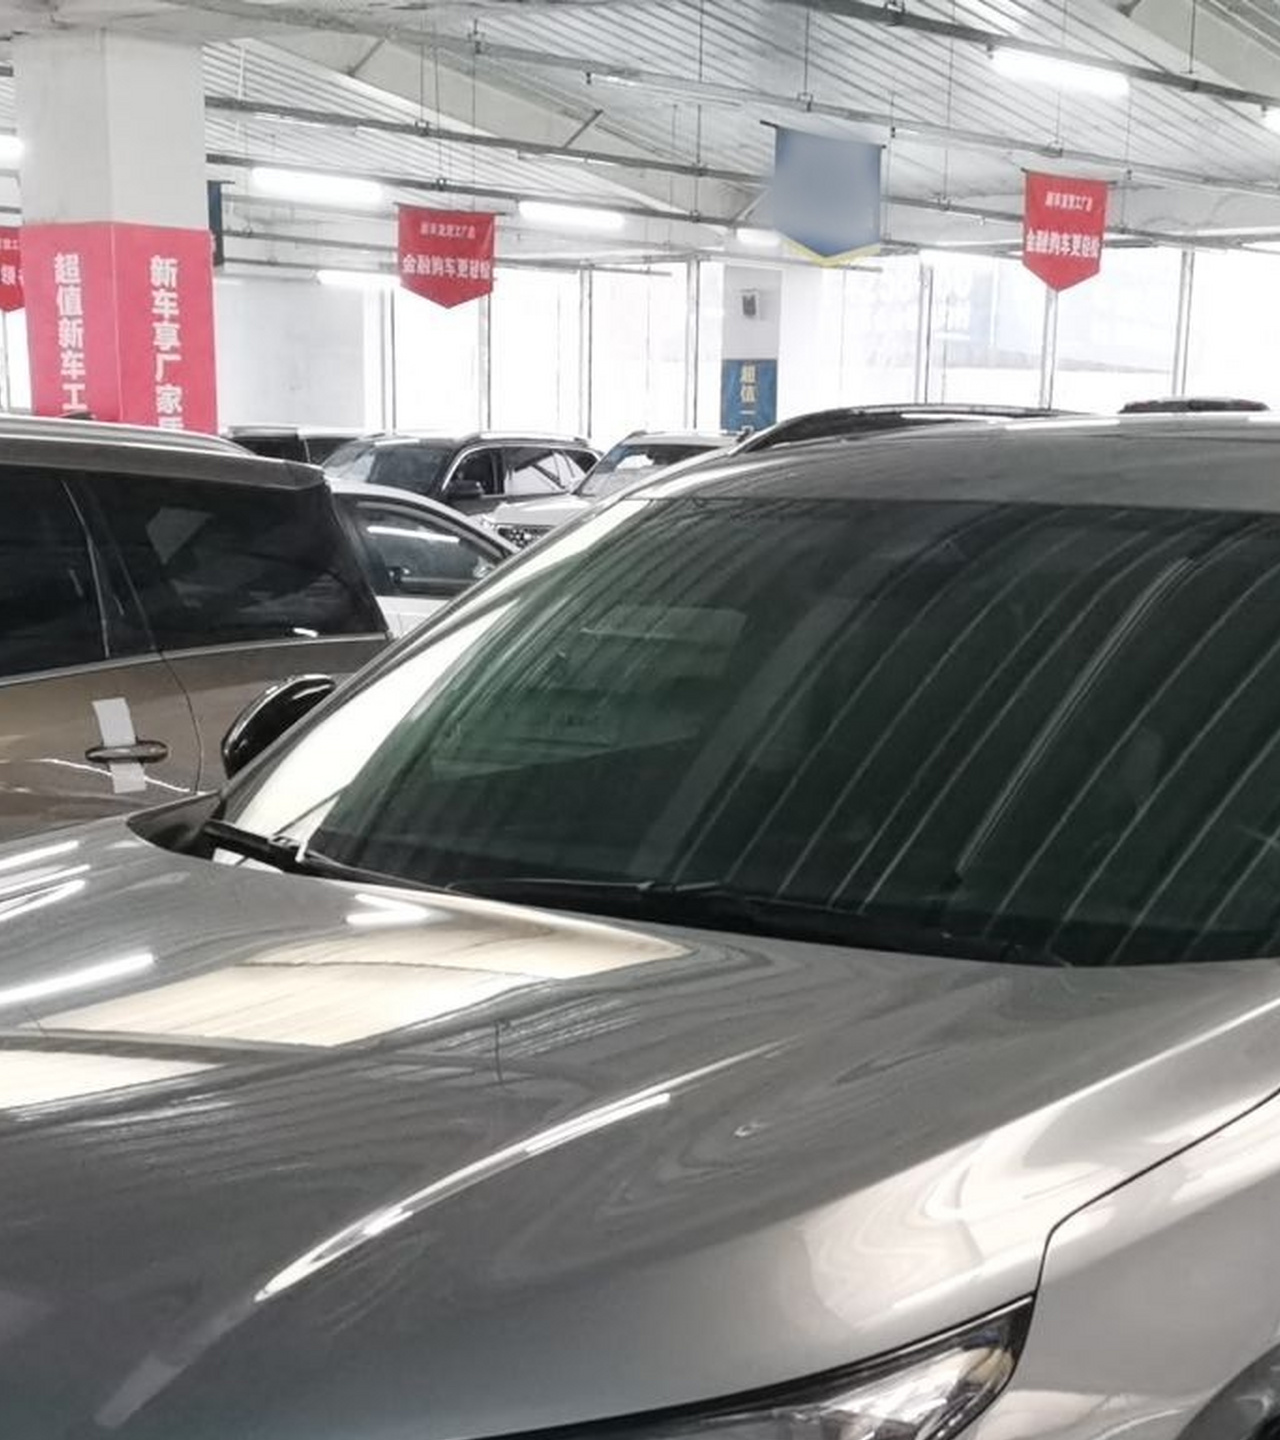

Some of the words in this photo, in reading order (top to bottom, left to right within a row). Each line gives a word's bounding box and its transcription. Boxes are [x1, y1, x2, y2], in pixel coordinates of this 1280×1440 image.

[54, 252, 88, 411] 超值新车工
